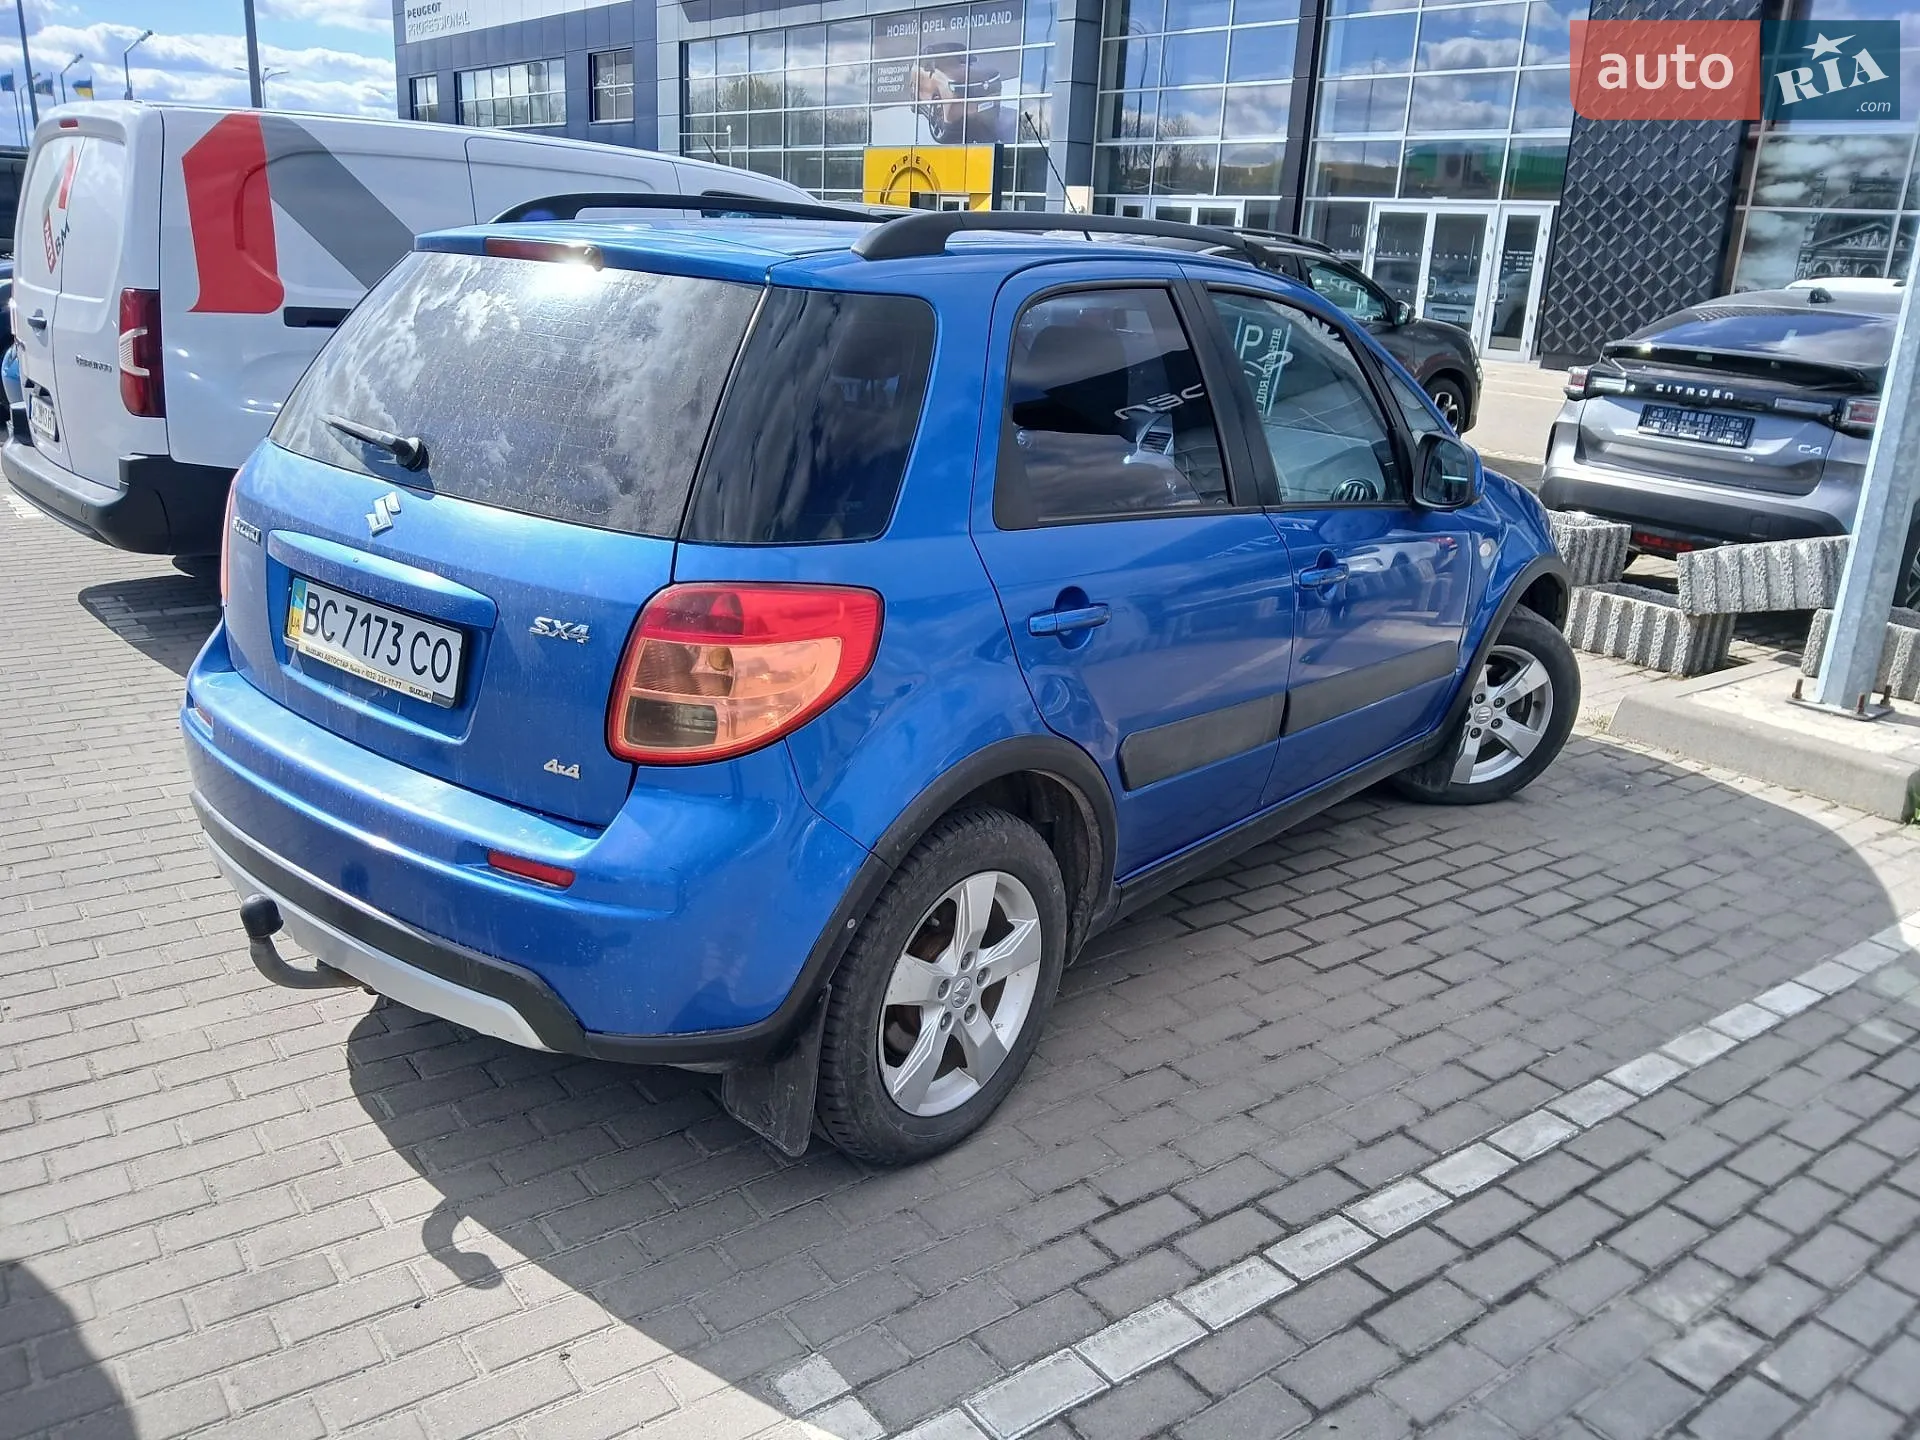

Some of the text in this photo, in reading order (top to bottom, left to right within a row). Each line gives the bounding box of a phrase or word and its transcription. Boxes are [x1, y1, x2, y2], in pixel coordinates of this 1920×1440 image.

[407, 2, 442, 18] PEUGEOT
[408, 9, 470, 37] PROFESSIONAL
[886, 11, 1012, 37] НОВИЙ OPEL GRANDLAND
[890, 155, 932, 175] OPEL
[1798, 444, 1822, 455] C4
[529, 616, 590, 643] SX4
[342, 605, 404, 666] 7173
[410, 631, 452, 683] CO
[409, 686, 432, 700] SUZUKI
